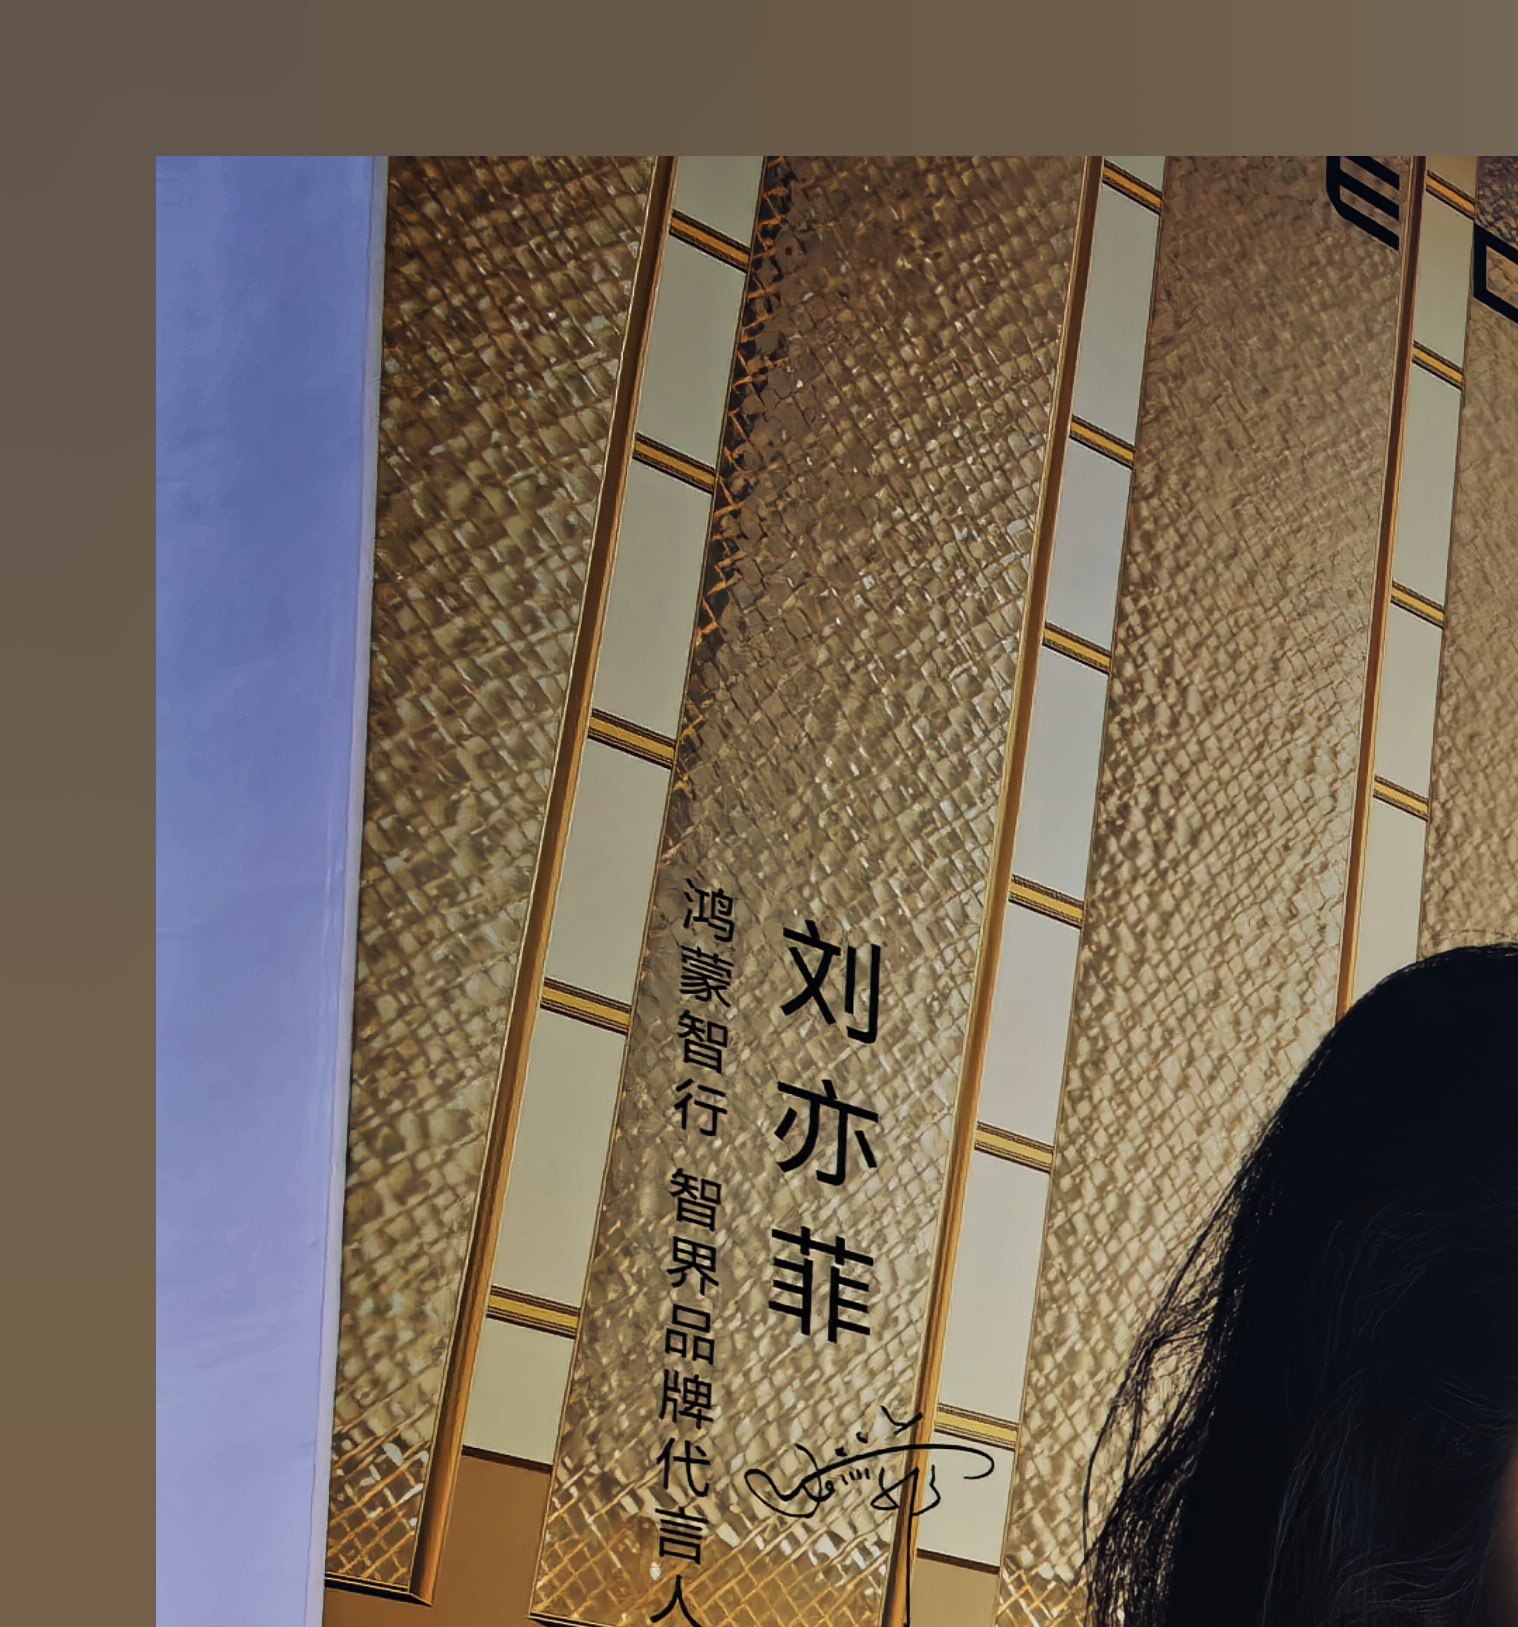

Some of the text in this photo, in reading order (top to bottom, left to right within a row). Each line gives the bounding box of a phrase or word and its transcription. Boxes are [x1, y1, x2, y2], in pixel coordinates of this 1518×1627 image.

[674, 878, 736, 1138] 鸿蒙智行
[768, 918, 882, 1344] 刘亦菲
